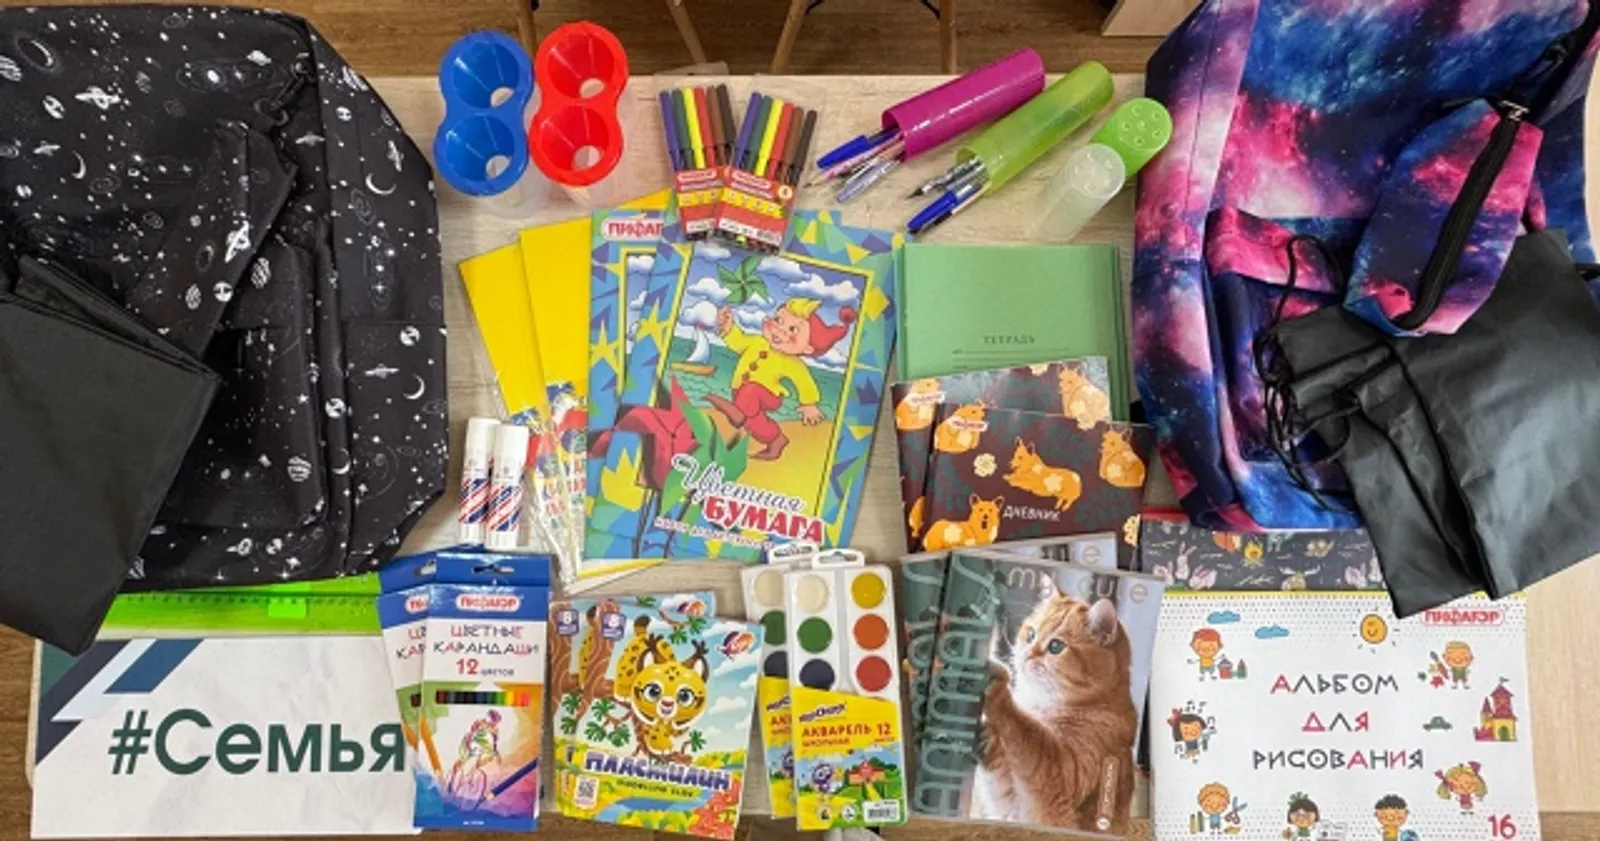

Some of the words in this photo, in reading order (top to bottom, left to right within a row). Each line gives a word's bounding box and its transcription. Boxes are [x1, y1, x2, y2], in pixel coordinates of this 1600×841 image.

[983, 335, 1036, 345] ТЕТРАДЬ
[673, 455, 803, 511] Цветная
[704, 496, 822, 544] БУМАГА
[1002, 505, 1061, 522] ДНЕВНИК
[450, 624, 525, 640] ЦВЕТНЫЕ
[433, 640, 540, 656] КАРАНДАШИ
[456, 658, 479, 676] 12
[1269, 673, 1400, 696] АЛЬБОМ
[802, 723, 872, 738] АКВАРЕЛЬ
[876, 722, 893, 736] 12
[1301, 711, 1369, 733] ДЛЯ
[108, 708, 406, 776] #Семья
[1252, 748, 1424, 770] РИСОВАНИЯ
[1487, 814, 1517, 840] 16
